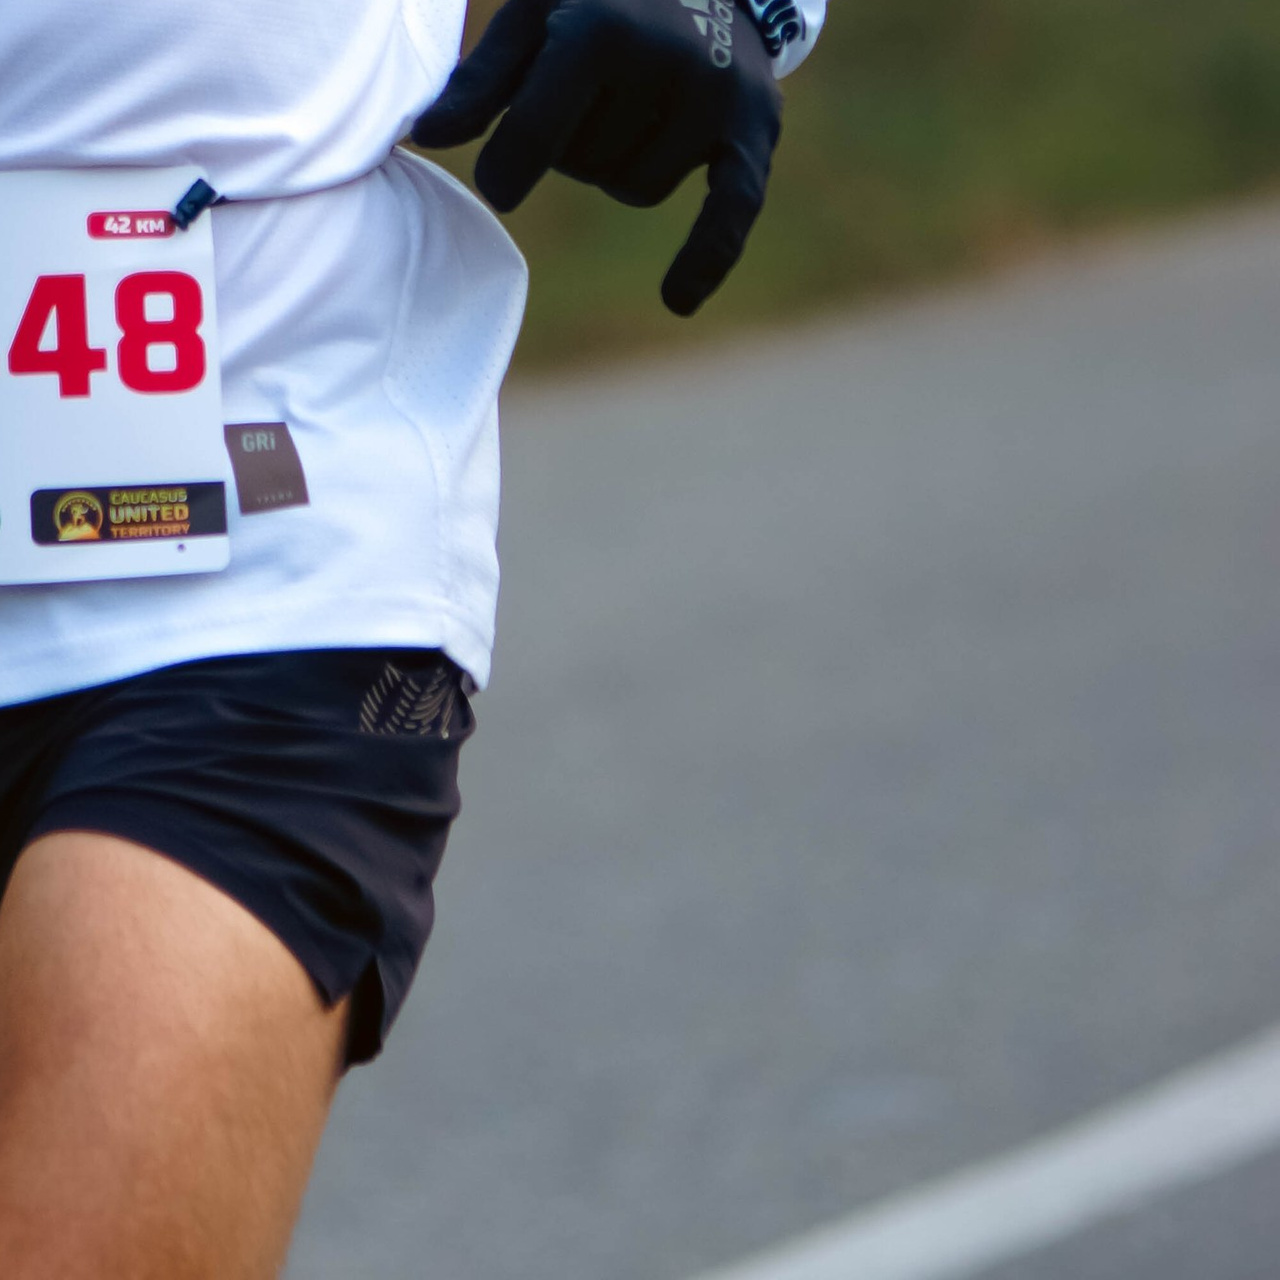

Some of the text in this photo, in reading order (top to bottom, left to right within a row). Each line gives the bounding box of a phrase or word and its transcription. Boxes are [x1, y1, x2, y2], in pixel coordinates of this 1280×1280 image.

[103, 214, 132, 234] 42
[110, 487, 188, 506] CAUCASUS
[109, 503, 191, 525] UNITED
[109, 521, 191, 540] TERRITORY
